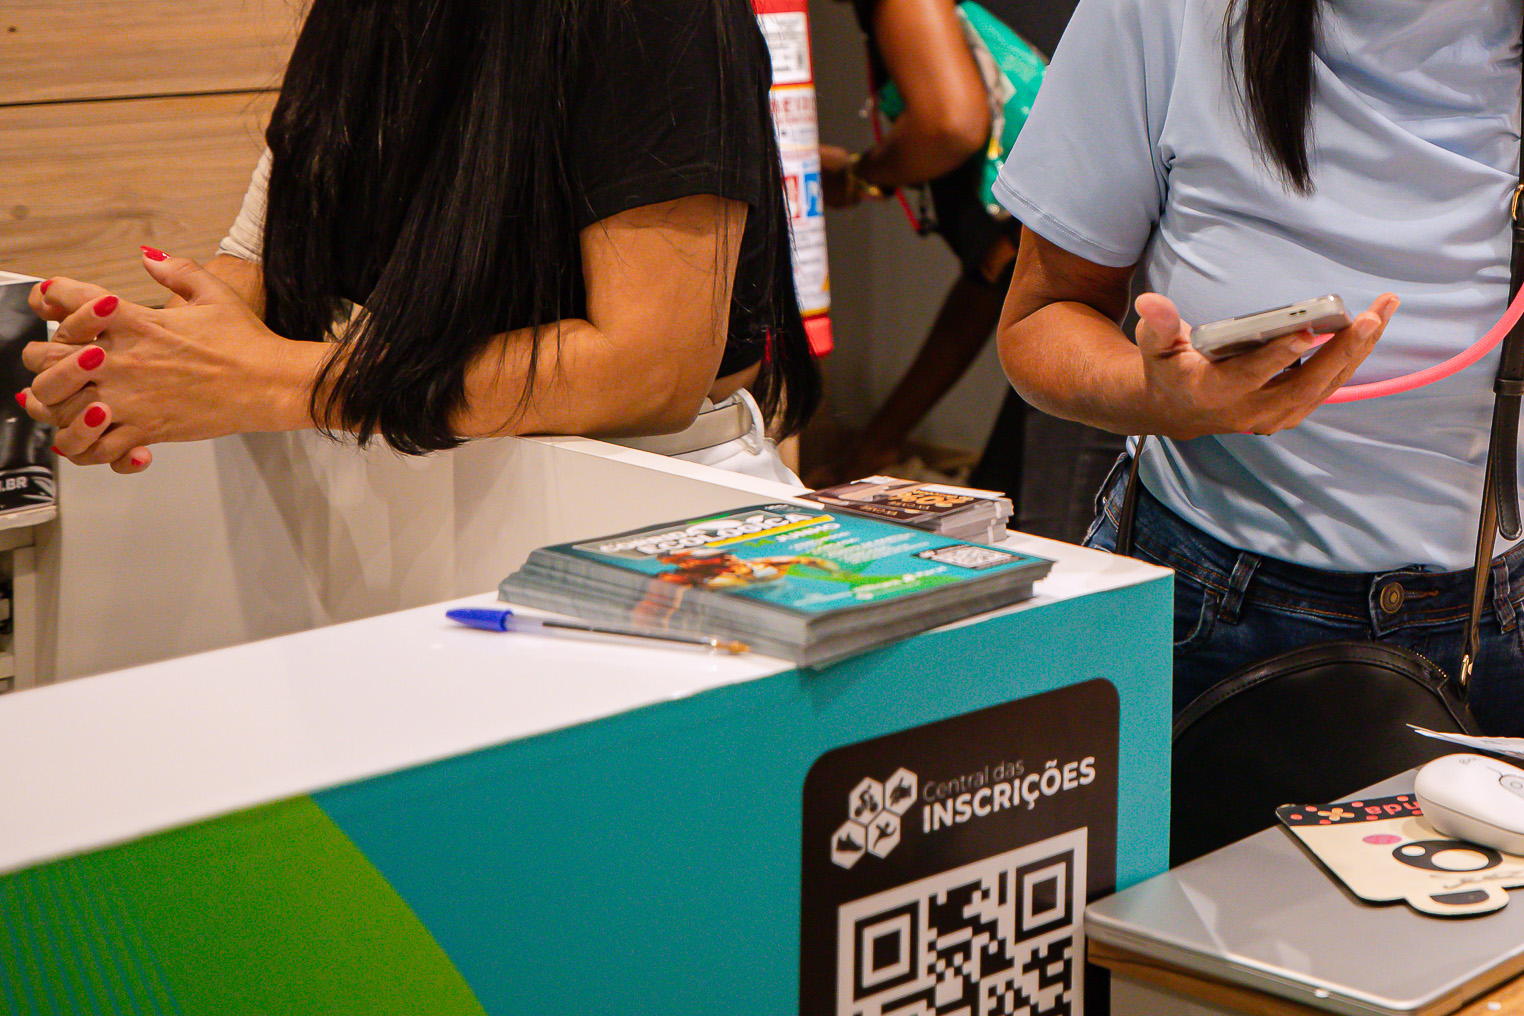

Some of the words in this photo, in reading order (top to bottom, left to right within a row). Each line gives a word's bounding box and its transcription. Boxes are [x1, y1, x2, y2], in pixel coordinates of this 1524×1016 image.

[922, 755, 1097, 834] INSCRIÇÕES
[923, 765, 989, 803] Central
[992, 759, 1025, 782] das
[1364, 800, 1421, 816] nda
